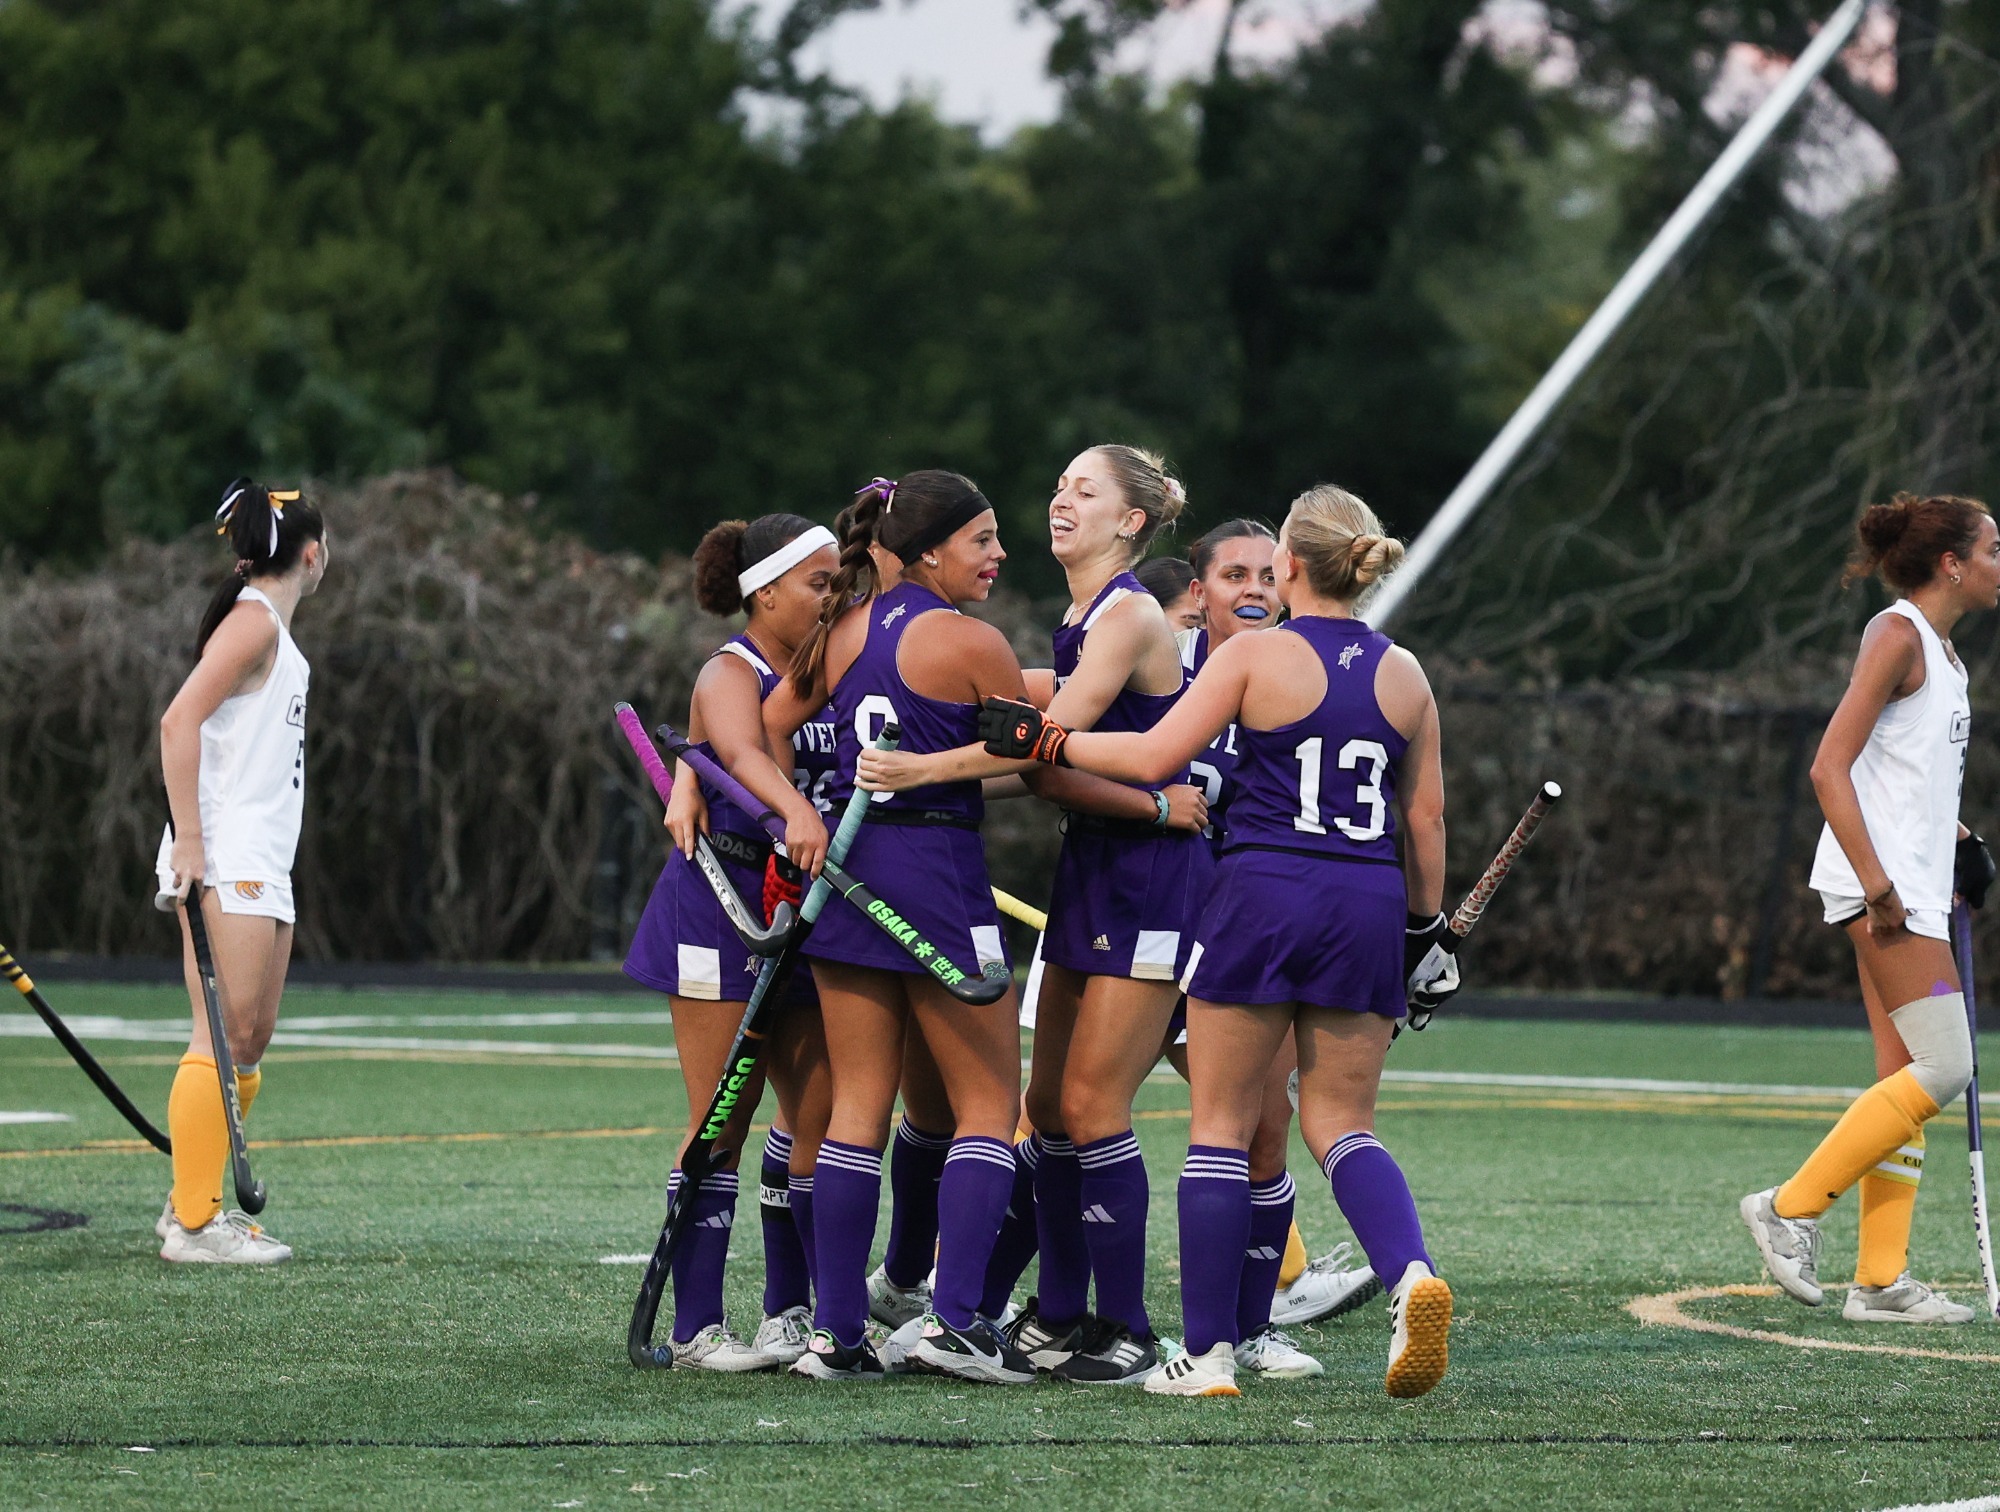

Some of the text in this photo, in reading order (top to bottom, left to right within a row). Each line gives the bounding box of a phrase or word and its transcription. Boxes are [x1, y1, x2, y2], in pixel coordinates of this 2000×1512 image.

[1294, 737, 1388, 840] 13
[867, 900, 966, 985] OSAKA 世界
[700, 1057, 757, 1139] OSAKA
